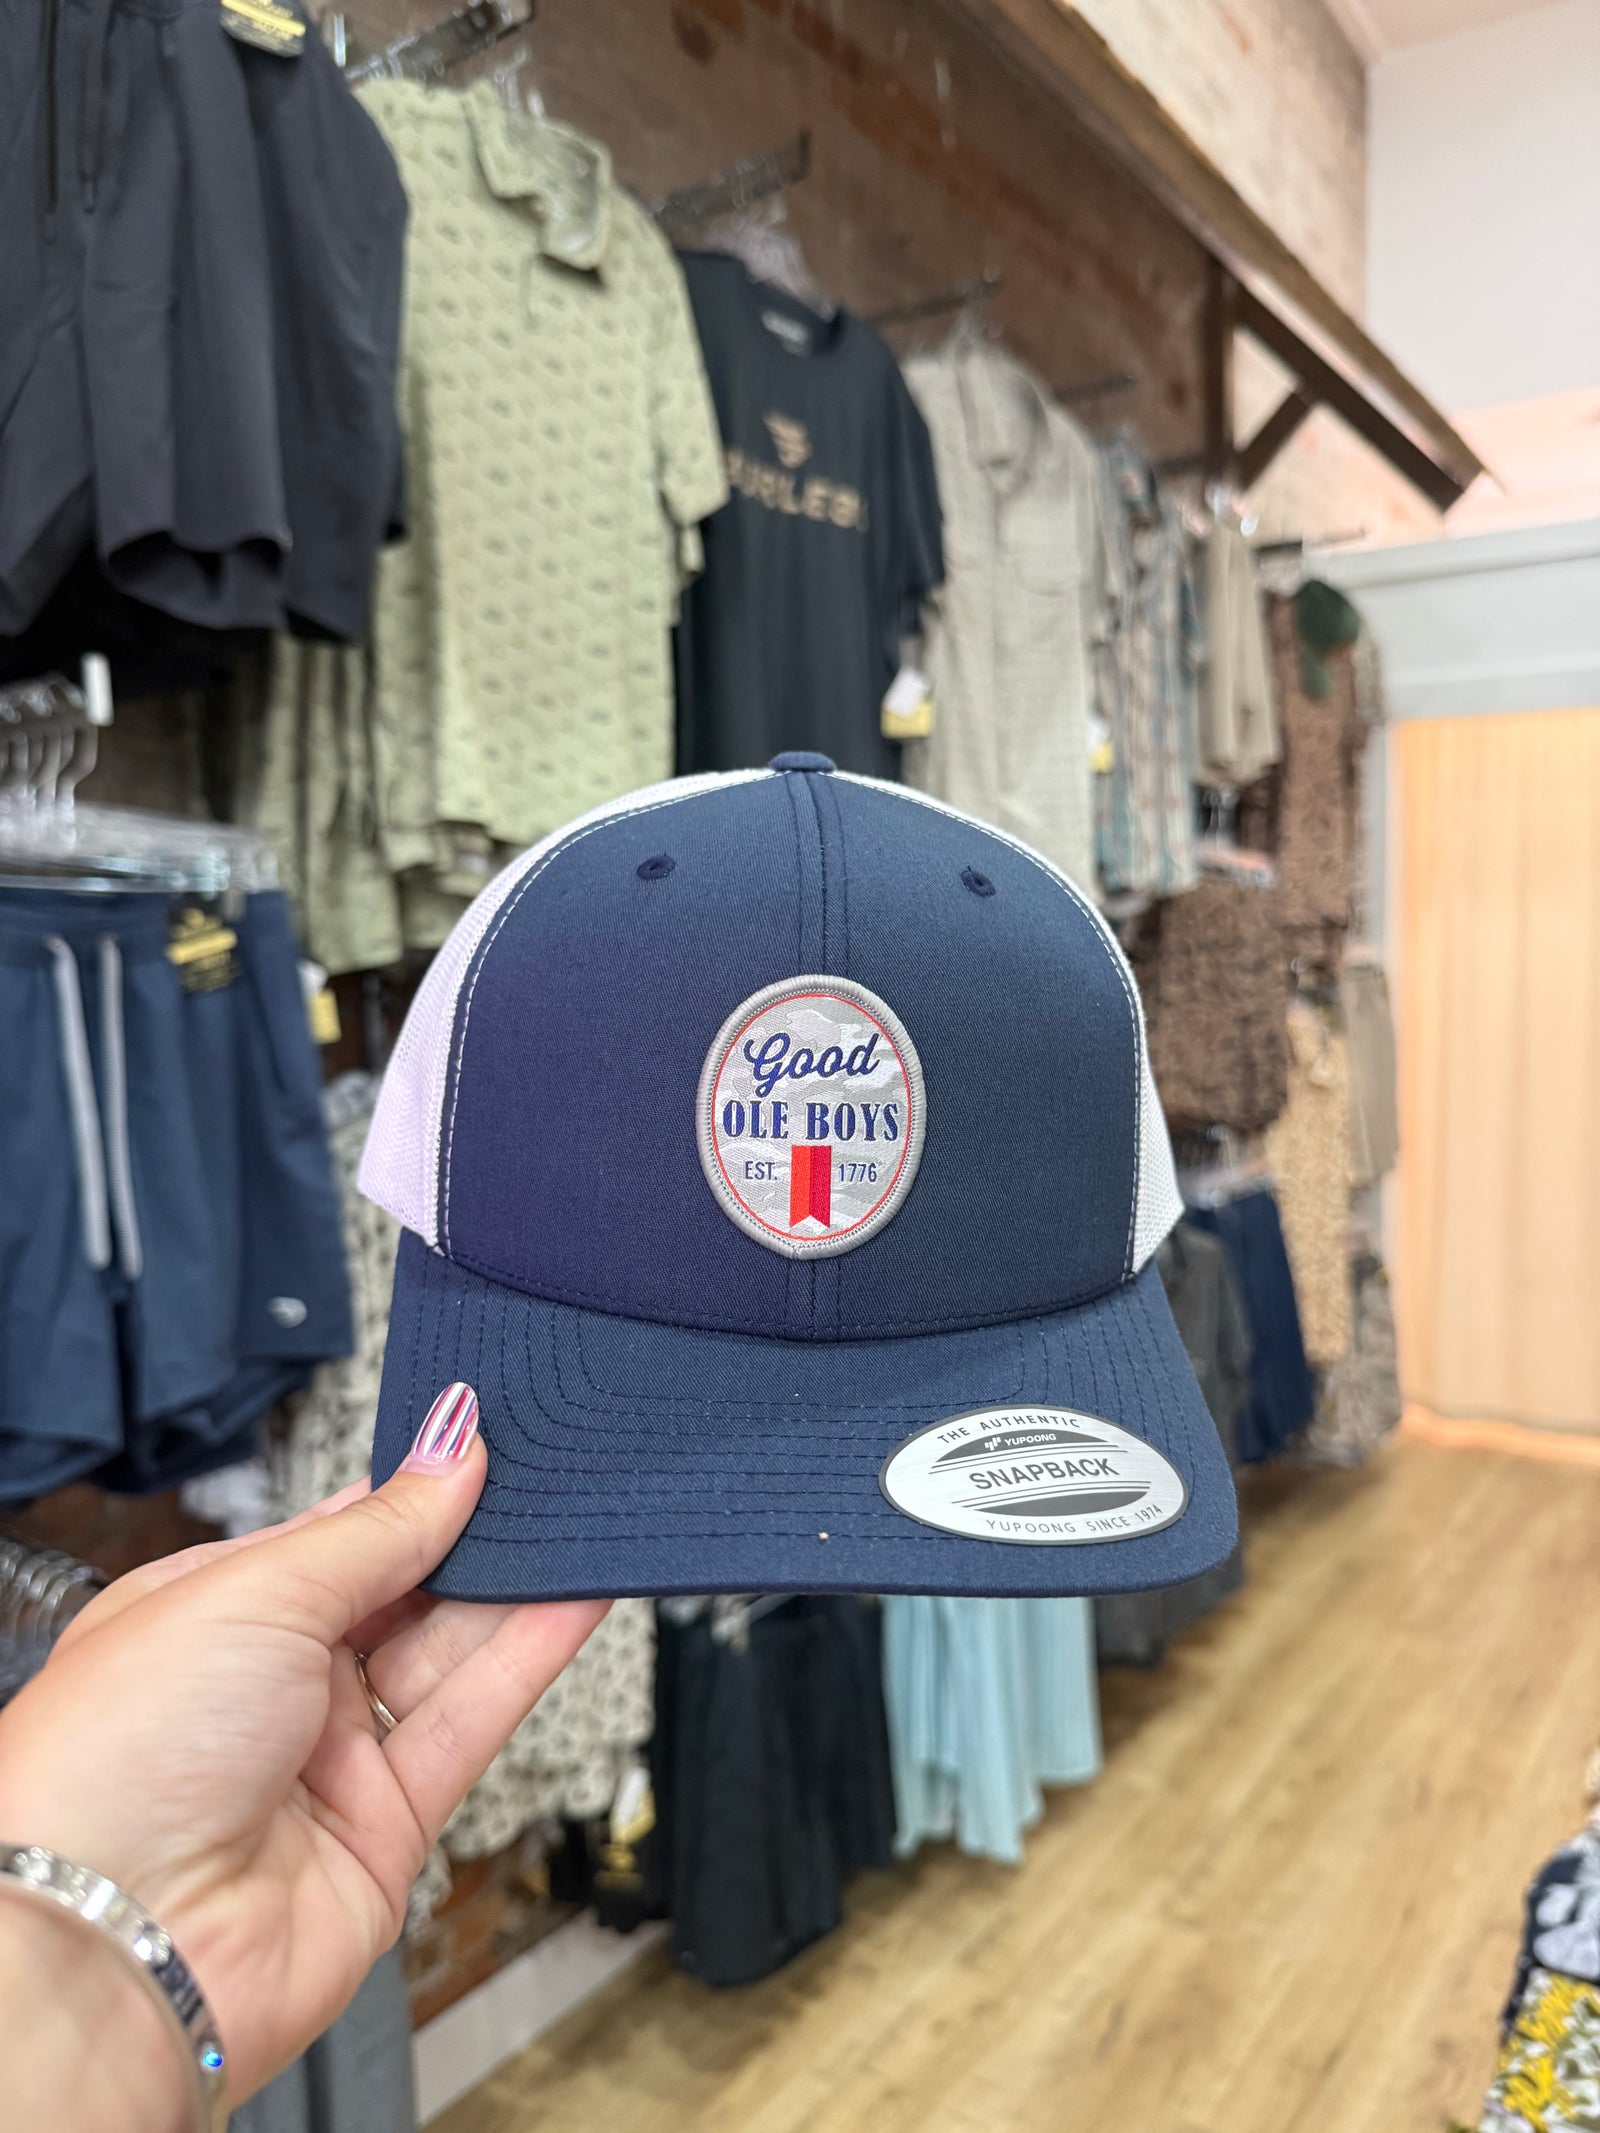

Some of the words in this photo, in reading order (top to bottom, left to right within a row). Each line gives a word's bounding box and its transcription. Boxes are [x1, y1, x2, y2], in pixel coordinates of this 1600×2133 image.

[743, 1033, 880, 1097] Good
[722, 1100, 788, 1139] OLE
[805, 1102, 898, 1141] BOYS
[744, 1161, 778, 1181] EST.
[838, 1163, 877, 1183] 1776
[937, 1427, 970, 1444] THE
[979, 1415, 1081, 1431] AUTHENTIC
[1004, 1433, 1057, 1447] YUPOONG
[968, 1457, 1120, 1491] SNAPBACK
[985, 1519, 1077, 1534] YUPOONG
[1086, 1515, 1130, 1532] SINCE
[1134, 1503, 1163, 1522] 1974
